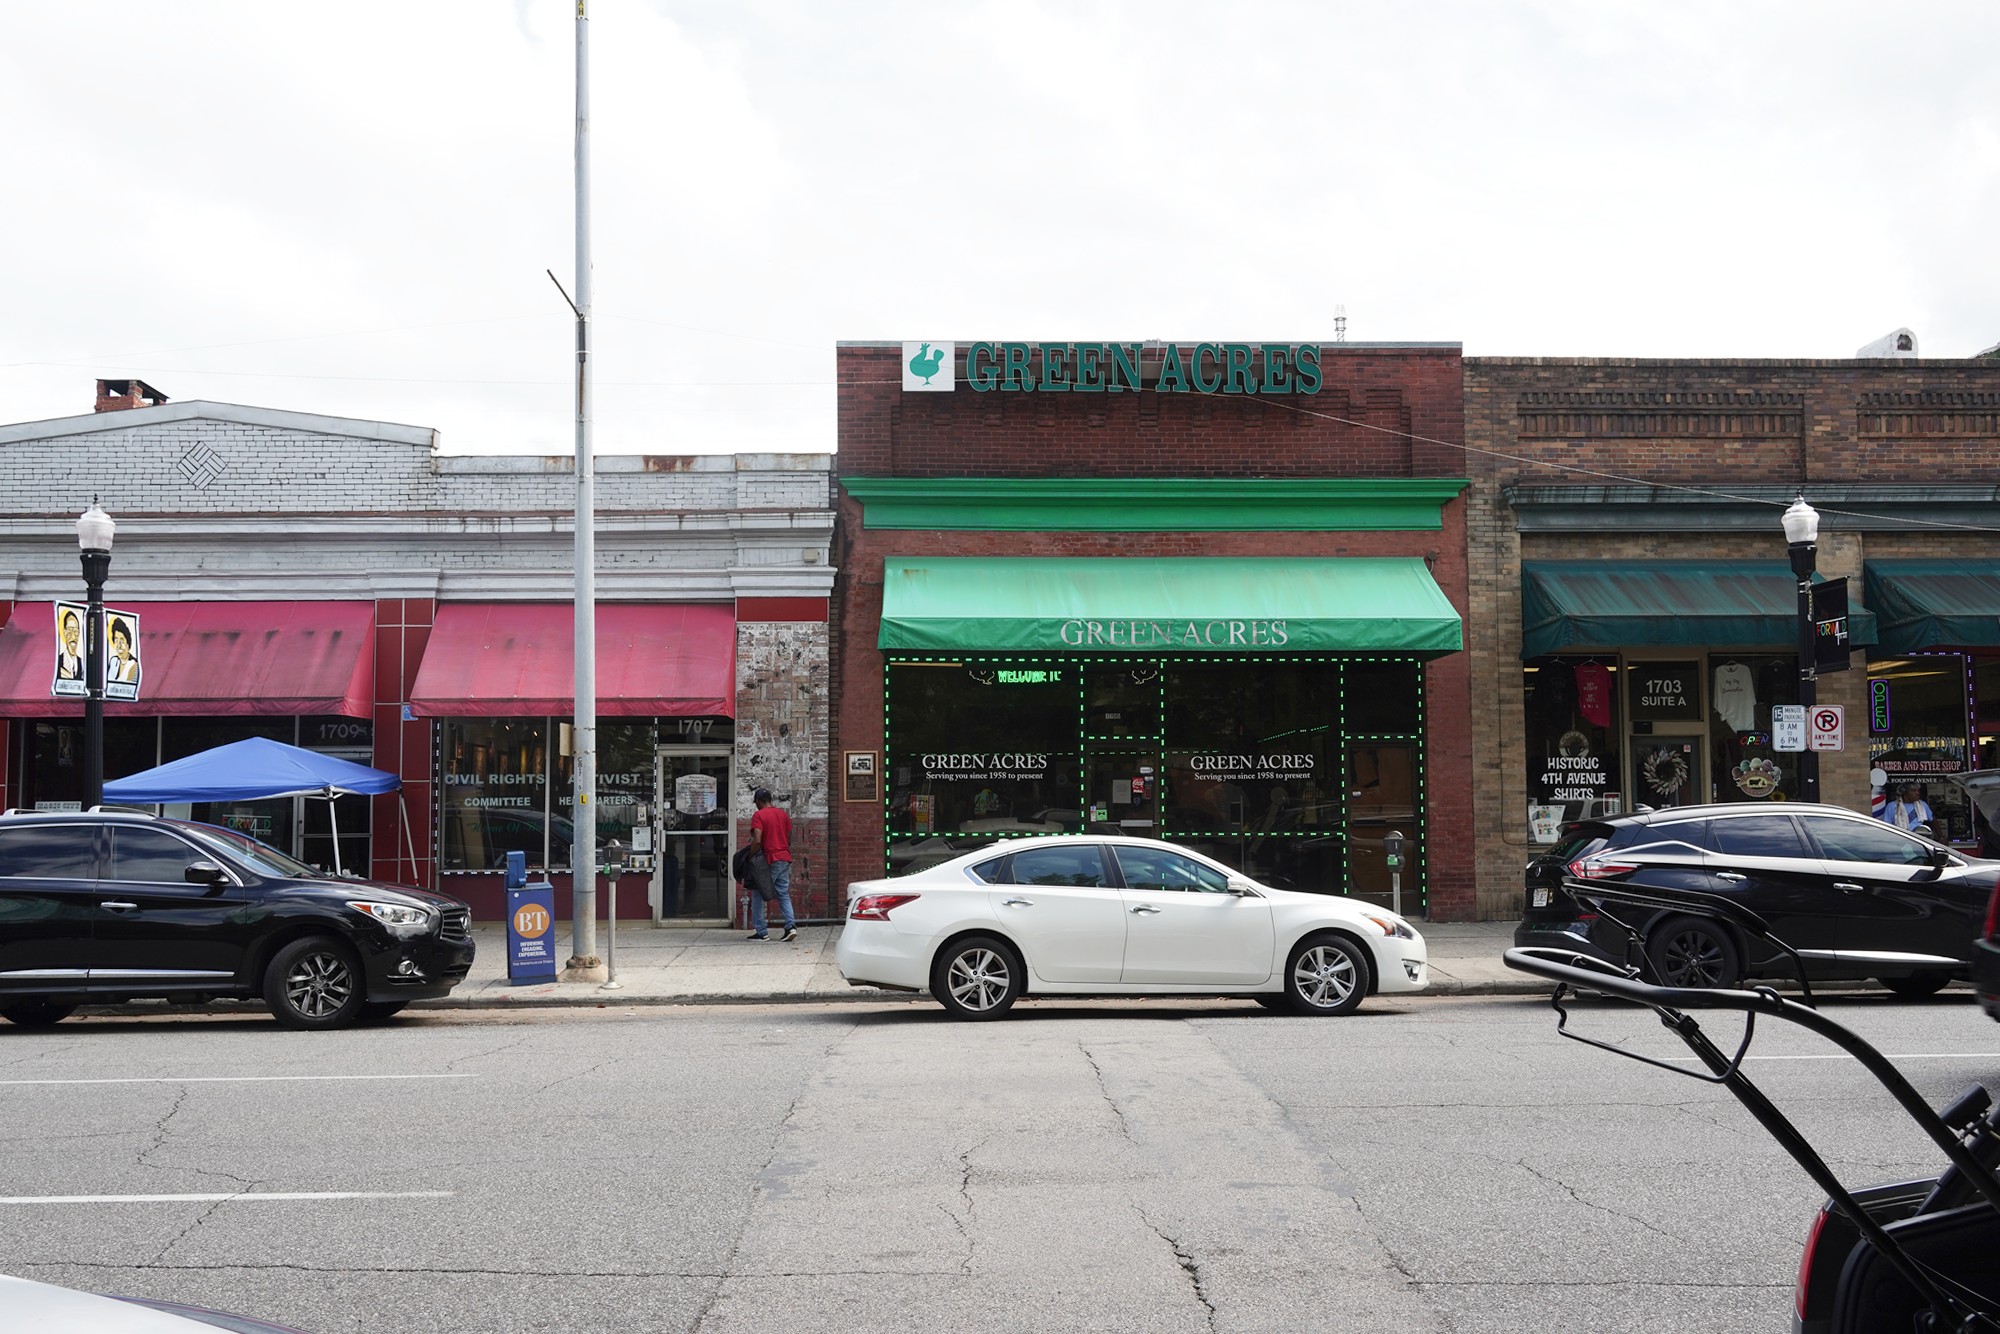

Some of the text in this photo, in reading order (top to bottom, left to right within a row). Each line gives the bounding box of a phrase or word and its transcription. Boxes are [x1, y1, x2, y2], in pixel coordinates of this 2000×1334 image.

[967, 341, 1323, 395] GREEN ACRES
[1060, 620, 1289, 645] GREEN ACRES
[1645, 679, 1682, 694] 1703
[1641, 696, 1687, 706] SUITE A
[1873, 682, 1887, 728] OPEN
[1774, 709, 1783, 719] 15
[320, 724, 359, 739] 1709
[679, 719, 714, 734] 1707
[1740, 735, 1770, 746] OPEN
[922, 754, 1047, 769] GREEN ACRES
[1190, 754, 1314, 770] GREEN ACRES
[1547, 756, 1599, 769] HISTORIC
[1875, 760, 1961, 771] BARBER AND STYLE SHOP
[444, 774, 484, 784] CIVIL
[489, 774, 545, 784] RIGHTS
[926, 771, 954, 781] Serving
[969, 771, 988, 779] since
[989, 771, 1007, 779] 1958
[1017, 772, 1043, 781] present
[1194, 772, 1222, 782] Serving
[1222, 774, 1237, 782] you
[1237, 772, 1256, 780] since
[1257, 771, 1275, 779] 1958
[1284, 772, 1311, 781] present
[1541, 772, 1606, 785] 4TH AVENUE
[1554, 787, 1594, 800] SHIRTS
[464, 797, 531, 806] COMMITTEE
[519, 911, 546, 932] BT
